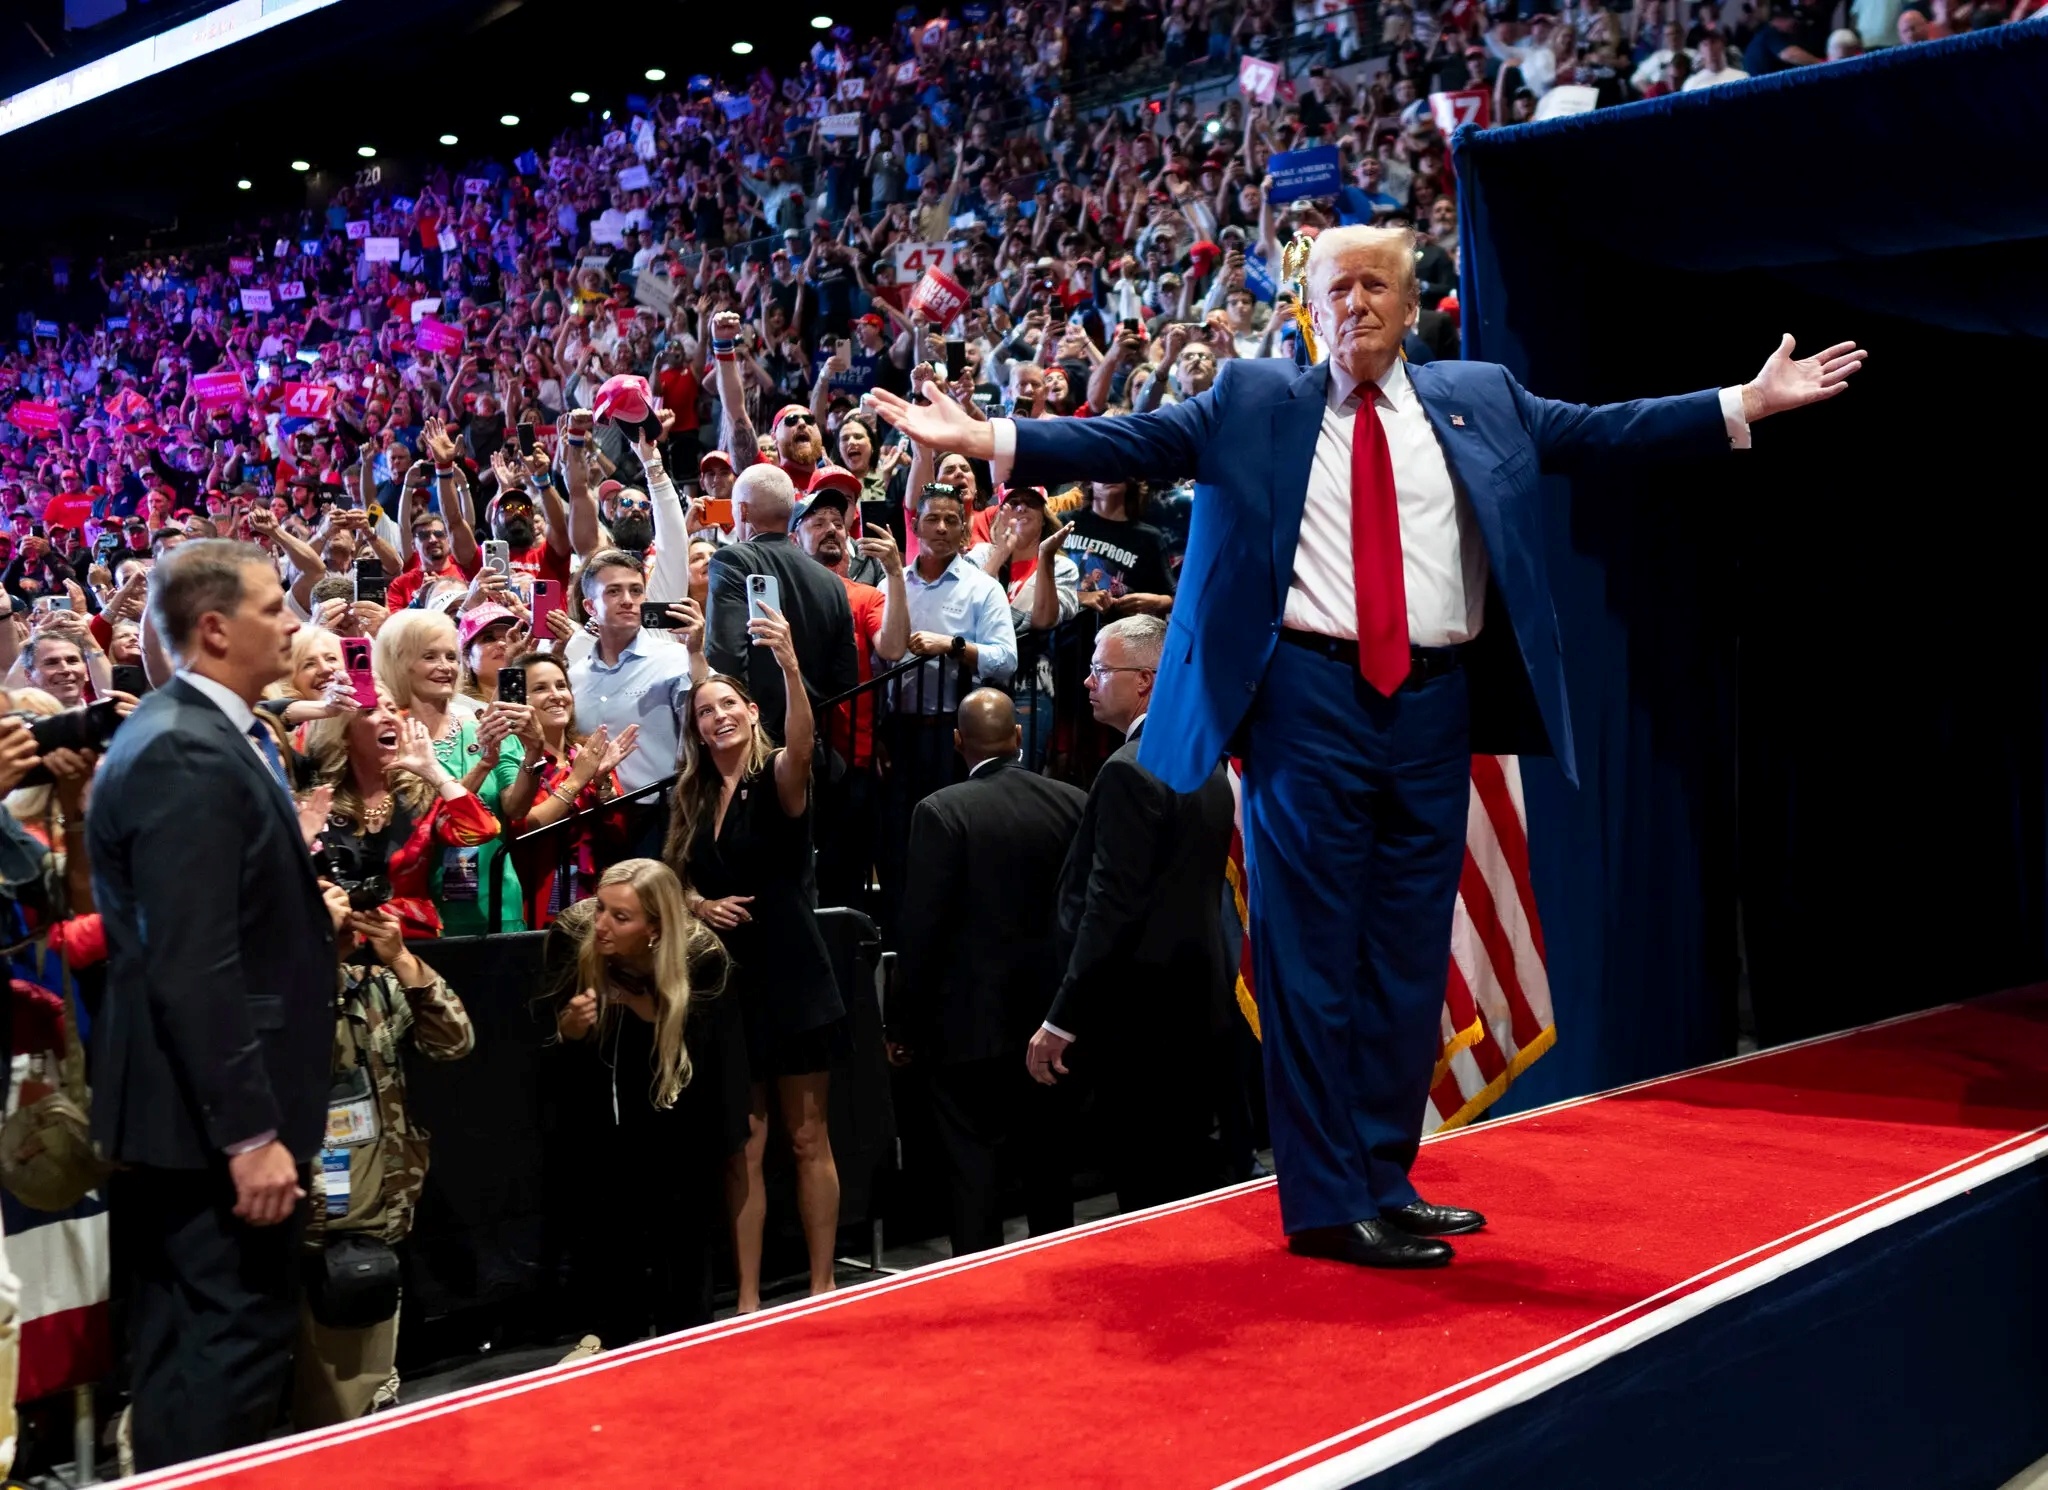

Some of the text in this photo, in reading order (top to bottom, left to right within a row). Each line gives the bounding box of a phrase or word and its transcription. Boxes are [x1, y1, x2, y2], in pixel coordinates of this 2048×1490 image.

[1240, 64, 1275, 95] 47
[355, 166, 381, 188] 220
[1297, 163, 1335, 174] AMERICA
[904, 249, 946, 271] 47
[283, 282, 300, 296] 47
[816, 361, 872, 376] TMP
[829, 373, 864, 385] ANCE
[290, 387, 328, 412] 47
[1062, 533, 1139, 568] BULLETPROOF
